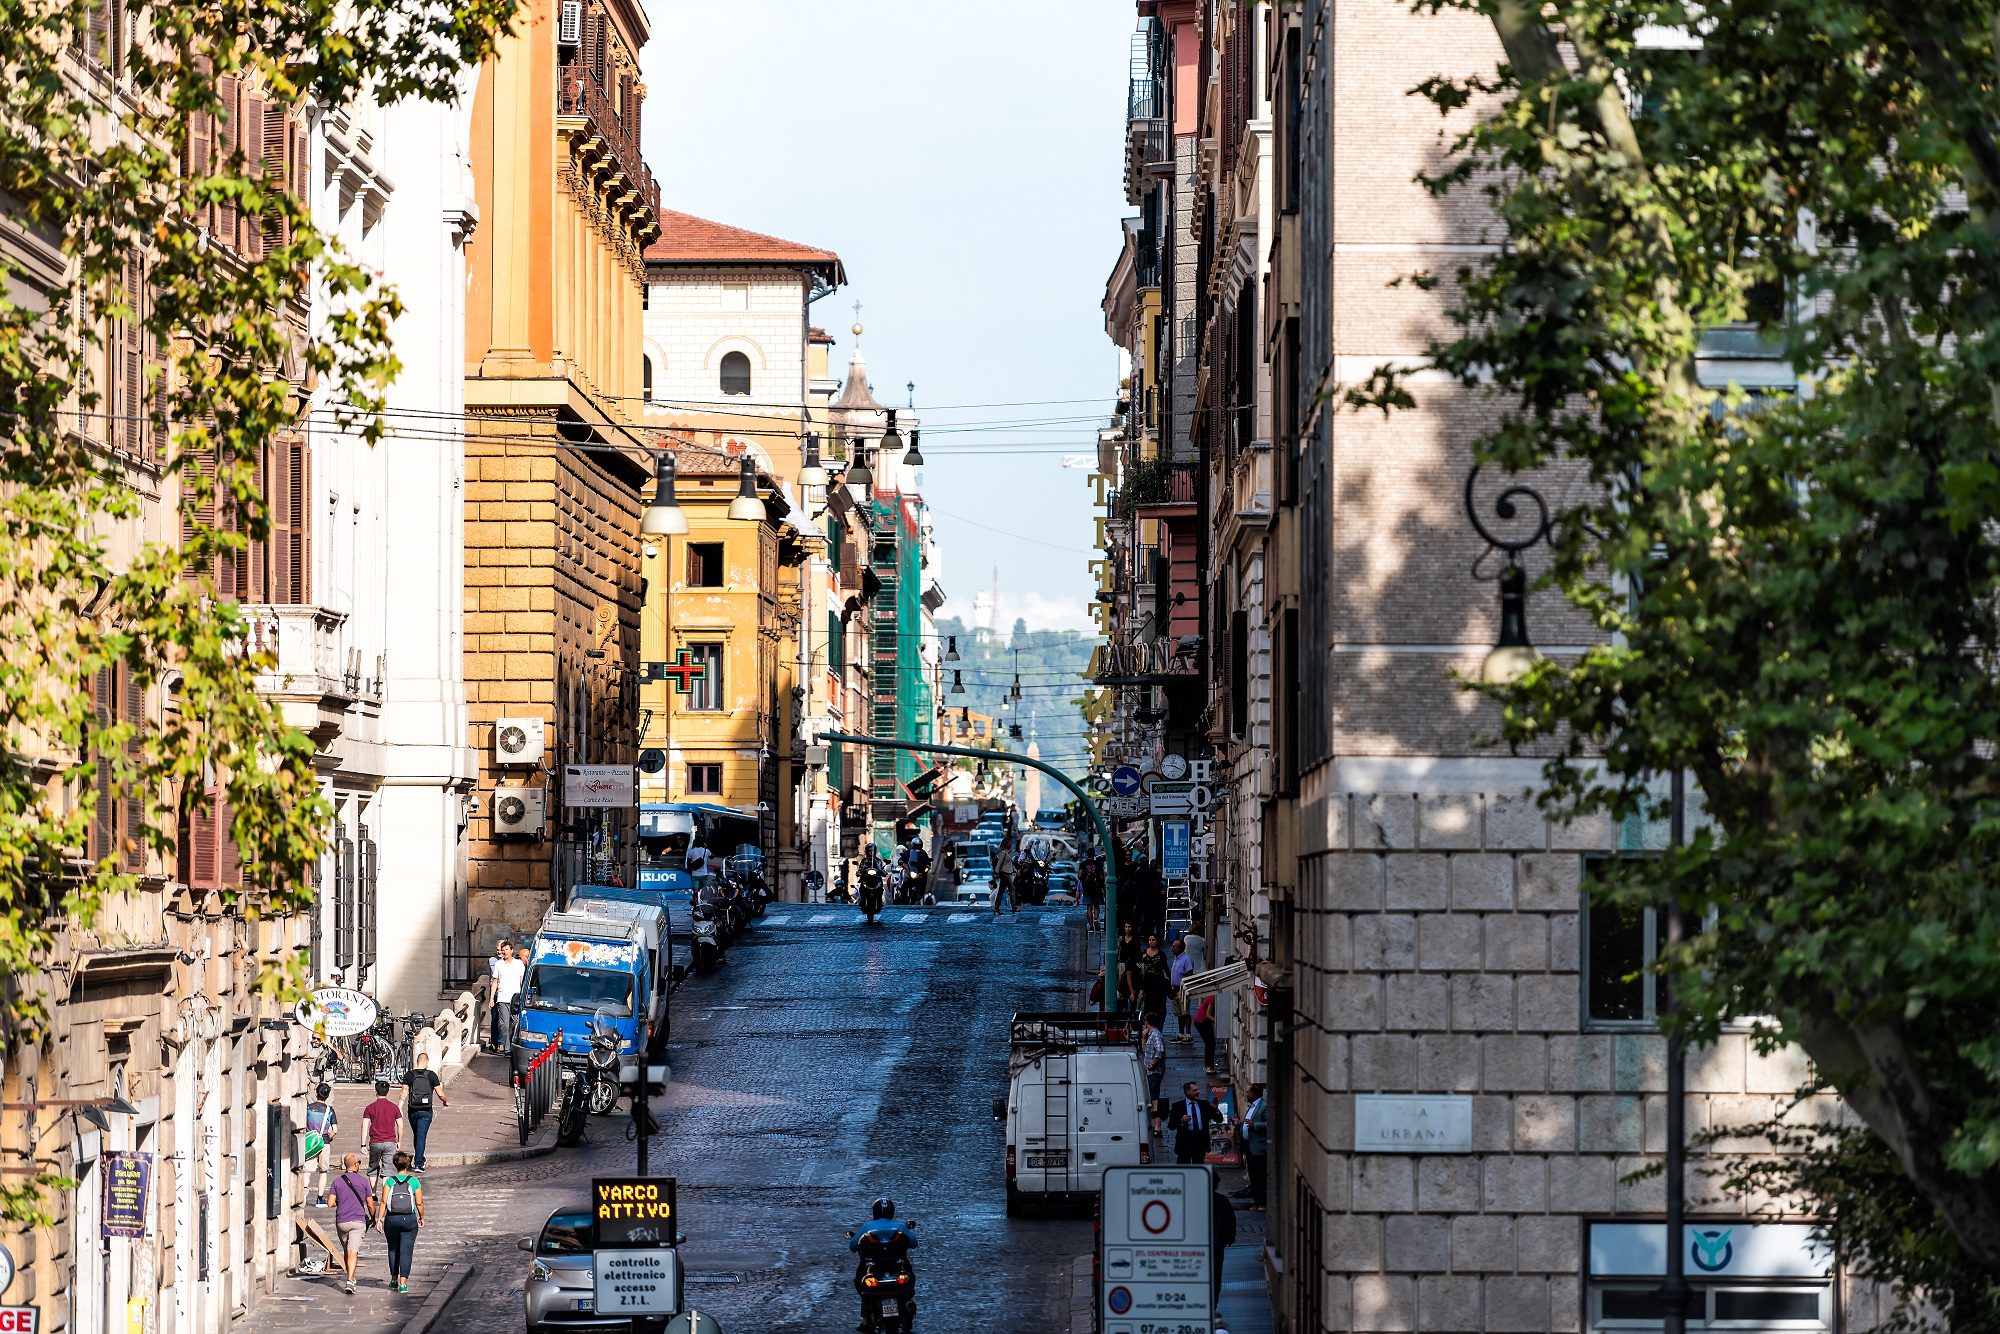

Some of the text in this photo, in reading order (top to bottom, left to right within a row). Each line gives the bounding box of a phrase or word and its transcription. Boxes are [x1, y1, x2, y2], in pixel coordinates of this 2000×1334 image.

[1168, 824, 1184, 846] T
[1380, 1128, 1446, 1140] URBANA
[598, 1185, 658, 1200] VARCO
[1131, 1187, 1155, 1195] traffico
[599, 1203, 670, 1218] ATTIVO
[609, 1258, 660, 1267] controllo
[604, 1270, 666, 1280] elettronico
[614, 1284, 656, 1292] accesso
[620, 1295, 650, 1305] Z.T.L.
[0, 1311, 32, 1332] GE
